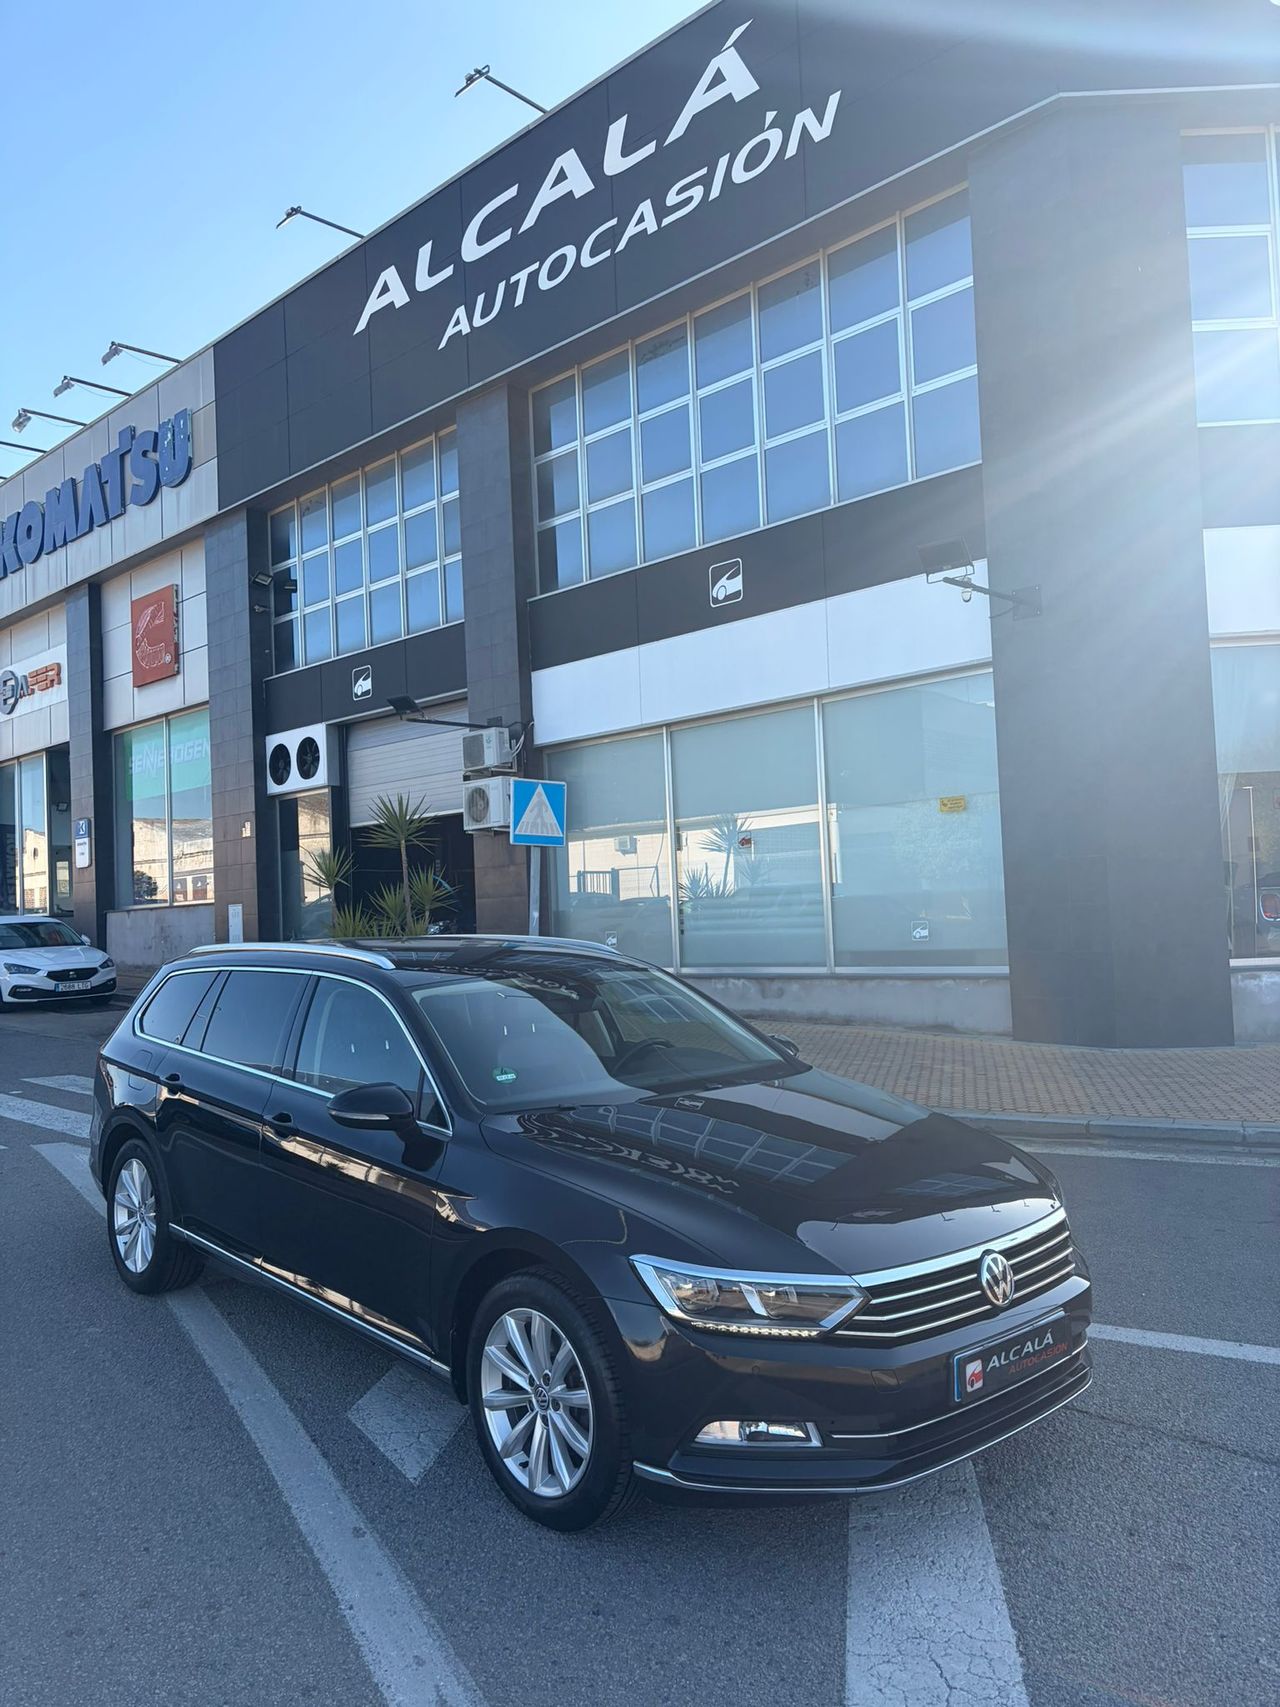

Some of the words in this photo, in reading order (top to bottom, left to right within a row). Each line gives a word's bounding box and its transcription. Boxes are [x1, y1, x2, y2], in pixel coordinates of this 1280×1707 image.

[353, 18, 760, 335] ALCALÁ
[438, 89, 842, 350] AUTOCASIÓN
[0, 408, 192, 581] KOMATSU
[986, 1329, 1054, 1372] ALCALÁ
